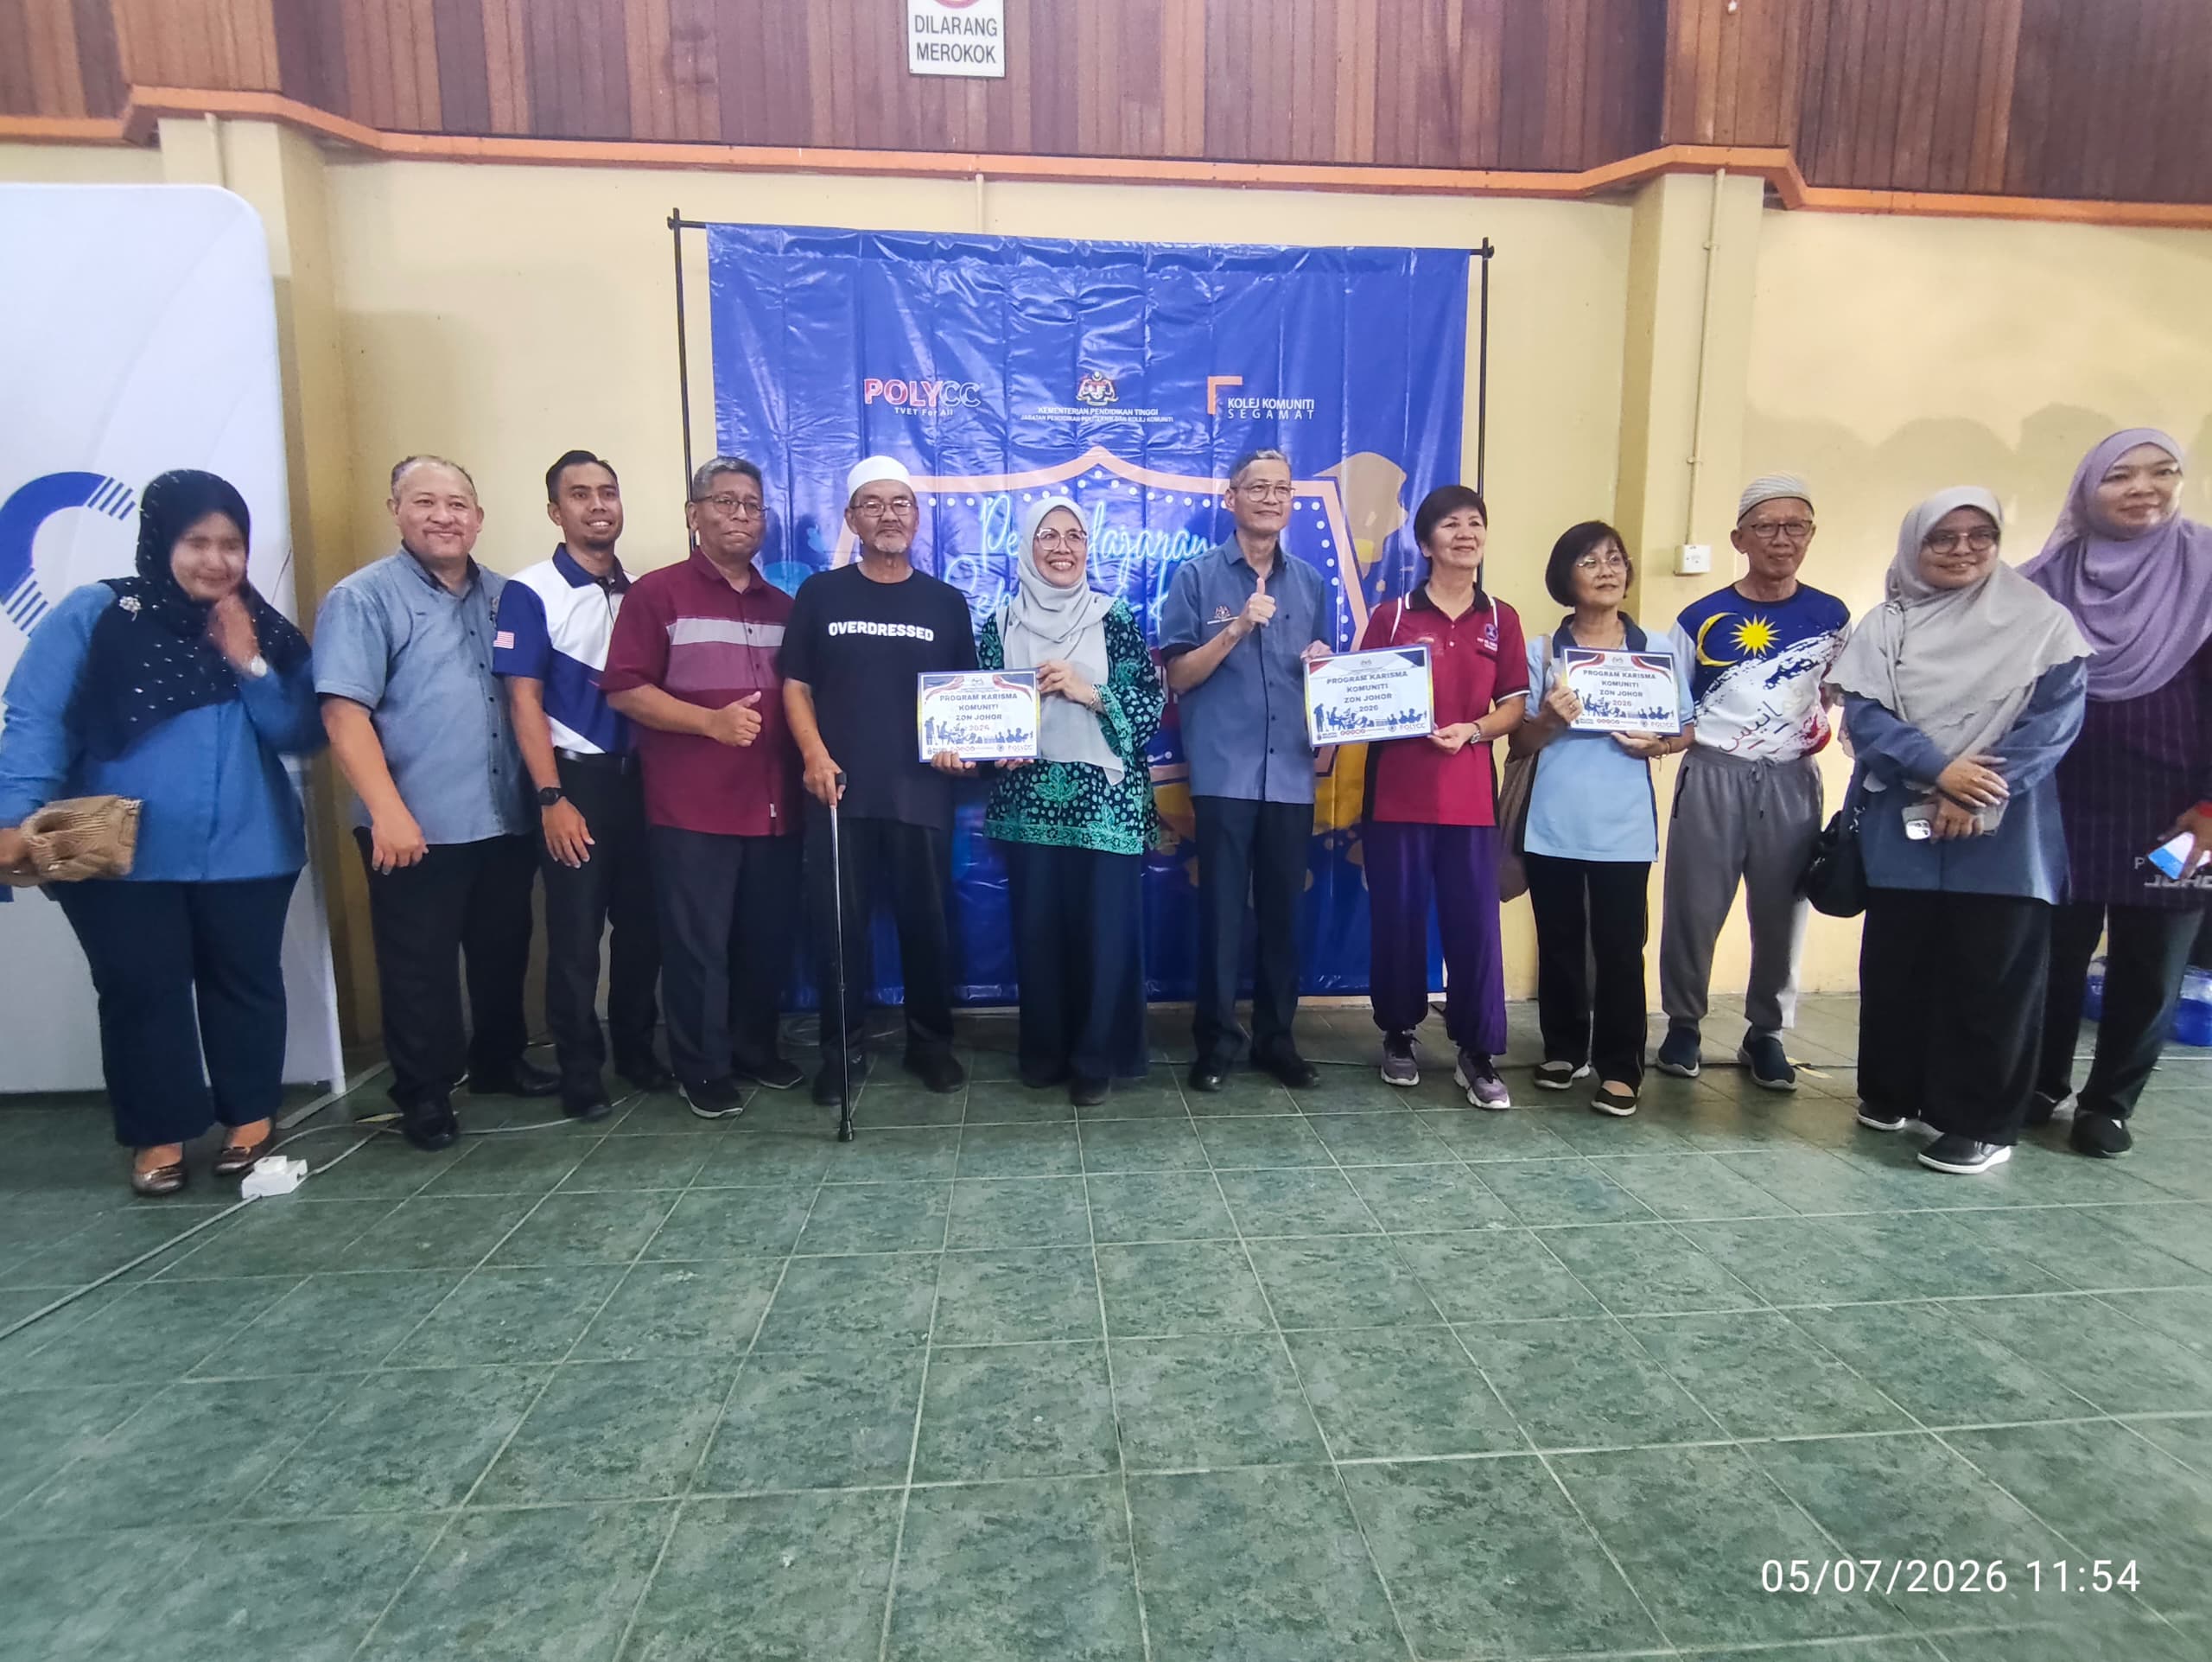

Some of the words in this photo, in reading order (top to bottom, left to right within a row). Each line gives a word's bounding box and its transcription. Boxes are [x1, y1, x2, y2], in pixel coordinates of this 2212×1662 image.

[914, 15, 998, 36] DILARANG
[916, 42, 996, 63] MEROKOK
[863, 378, 982, 408] POLYCC
[1227, 398, 1260, 409] KOLEJ
[1262, 398, 1315, 411] KOMUNITI
[894, 407, 918, 416] TVET
[921, 408, 938, 417] For
[1038, 407, 1089, 416] KEMENTERIAN
[1134, 408, 1159, 417] TINGGI
[1227, 409, 1314, 420] SEGAMAT
[828, 621, 934, 641] OVERDRESSED
[1326, 675, 1368, 685] PROGRAM
[1370, 671, 1408, 680] KARISMA
[1346, 684, 1389, 692] KOMUNITI
[1363, 693, 1392, 702] JOHOR
